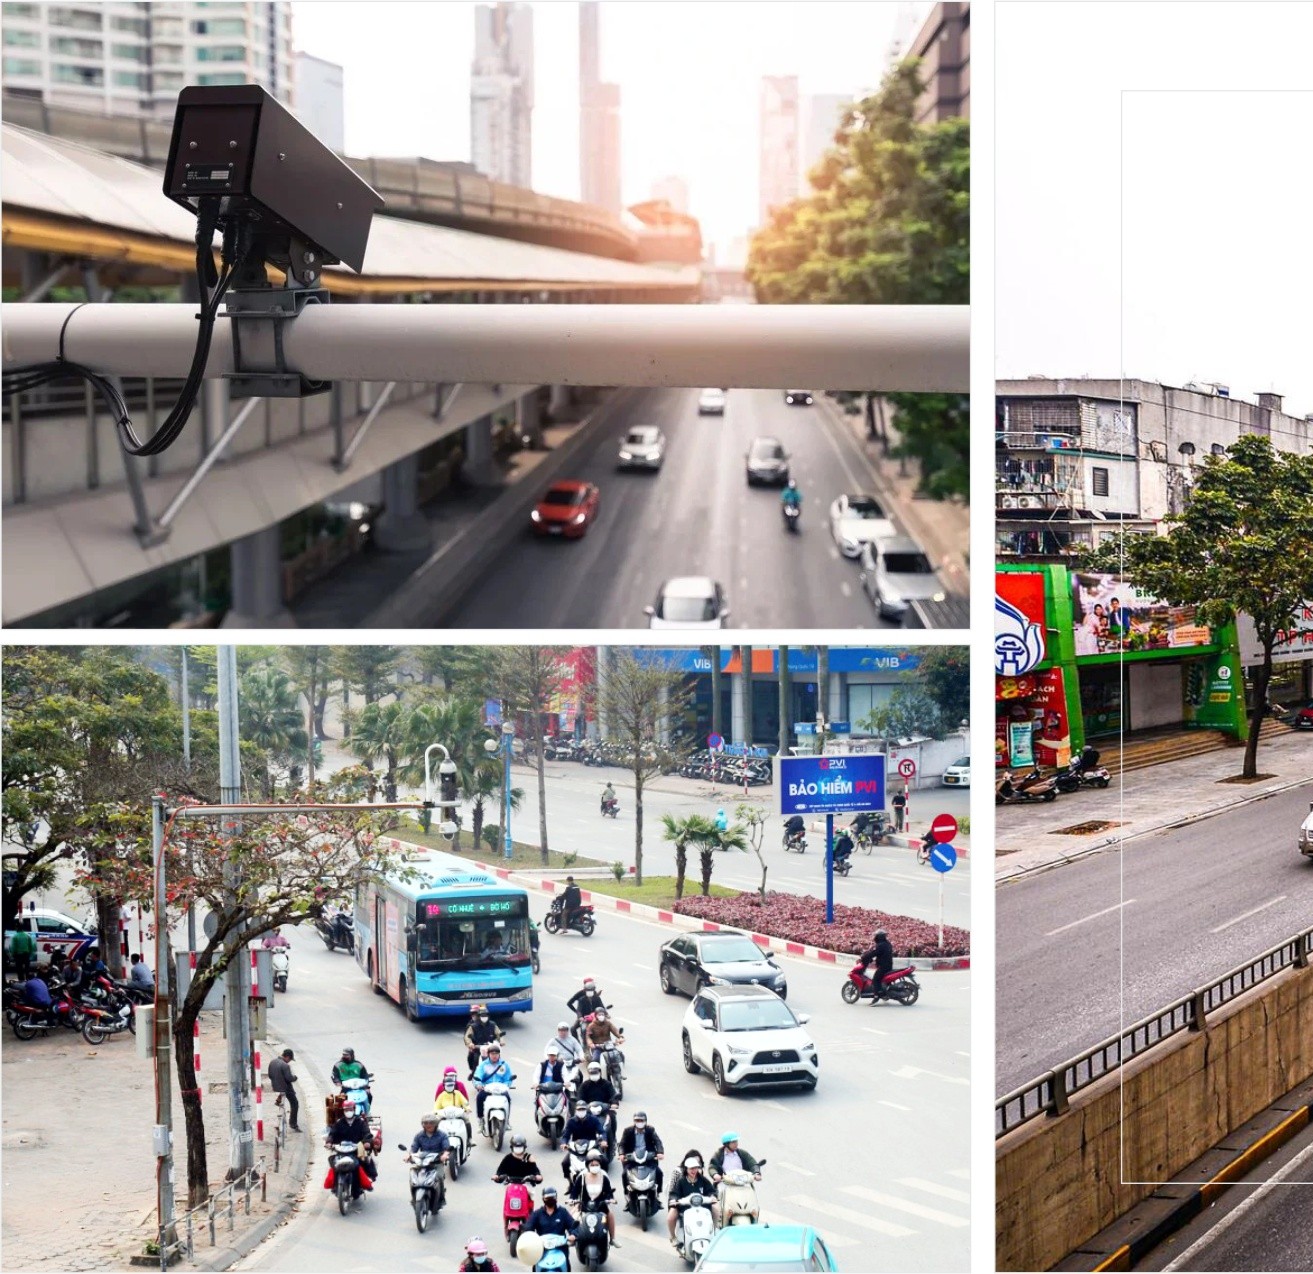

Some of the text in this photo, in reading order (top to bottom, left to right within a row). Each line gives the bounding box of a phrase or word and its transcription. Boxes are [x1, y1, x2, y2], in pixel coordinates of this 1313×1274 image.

[694, 658, 711, 669] VIB
[875, 657, 900, 668] VIB
[789, 775, 877, 796] BẢO HIỂM PVI
